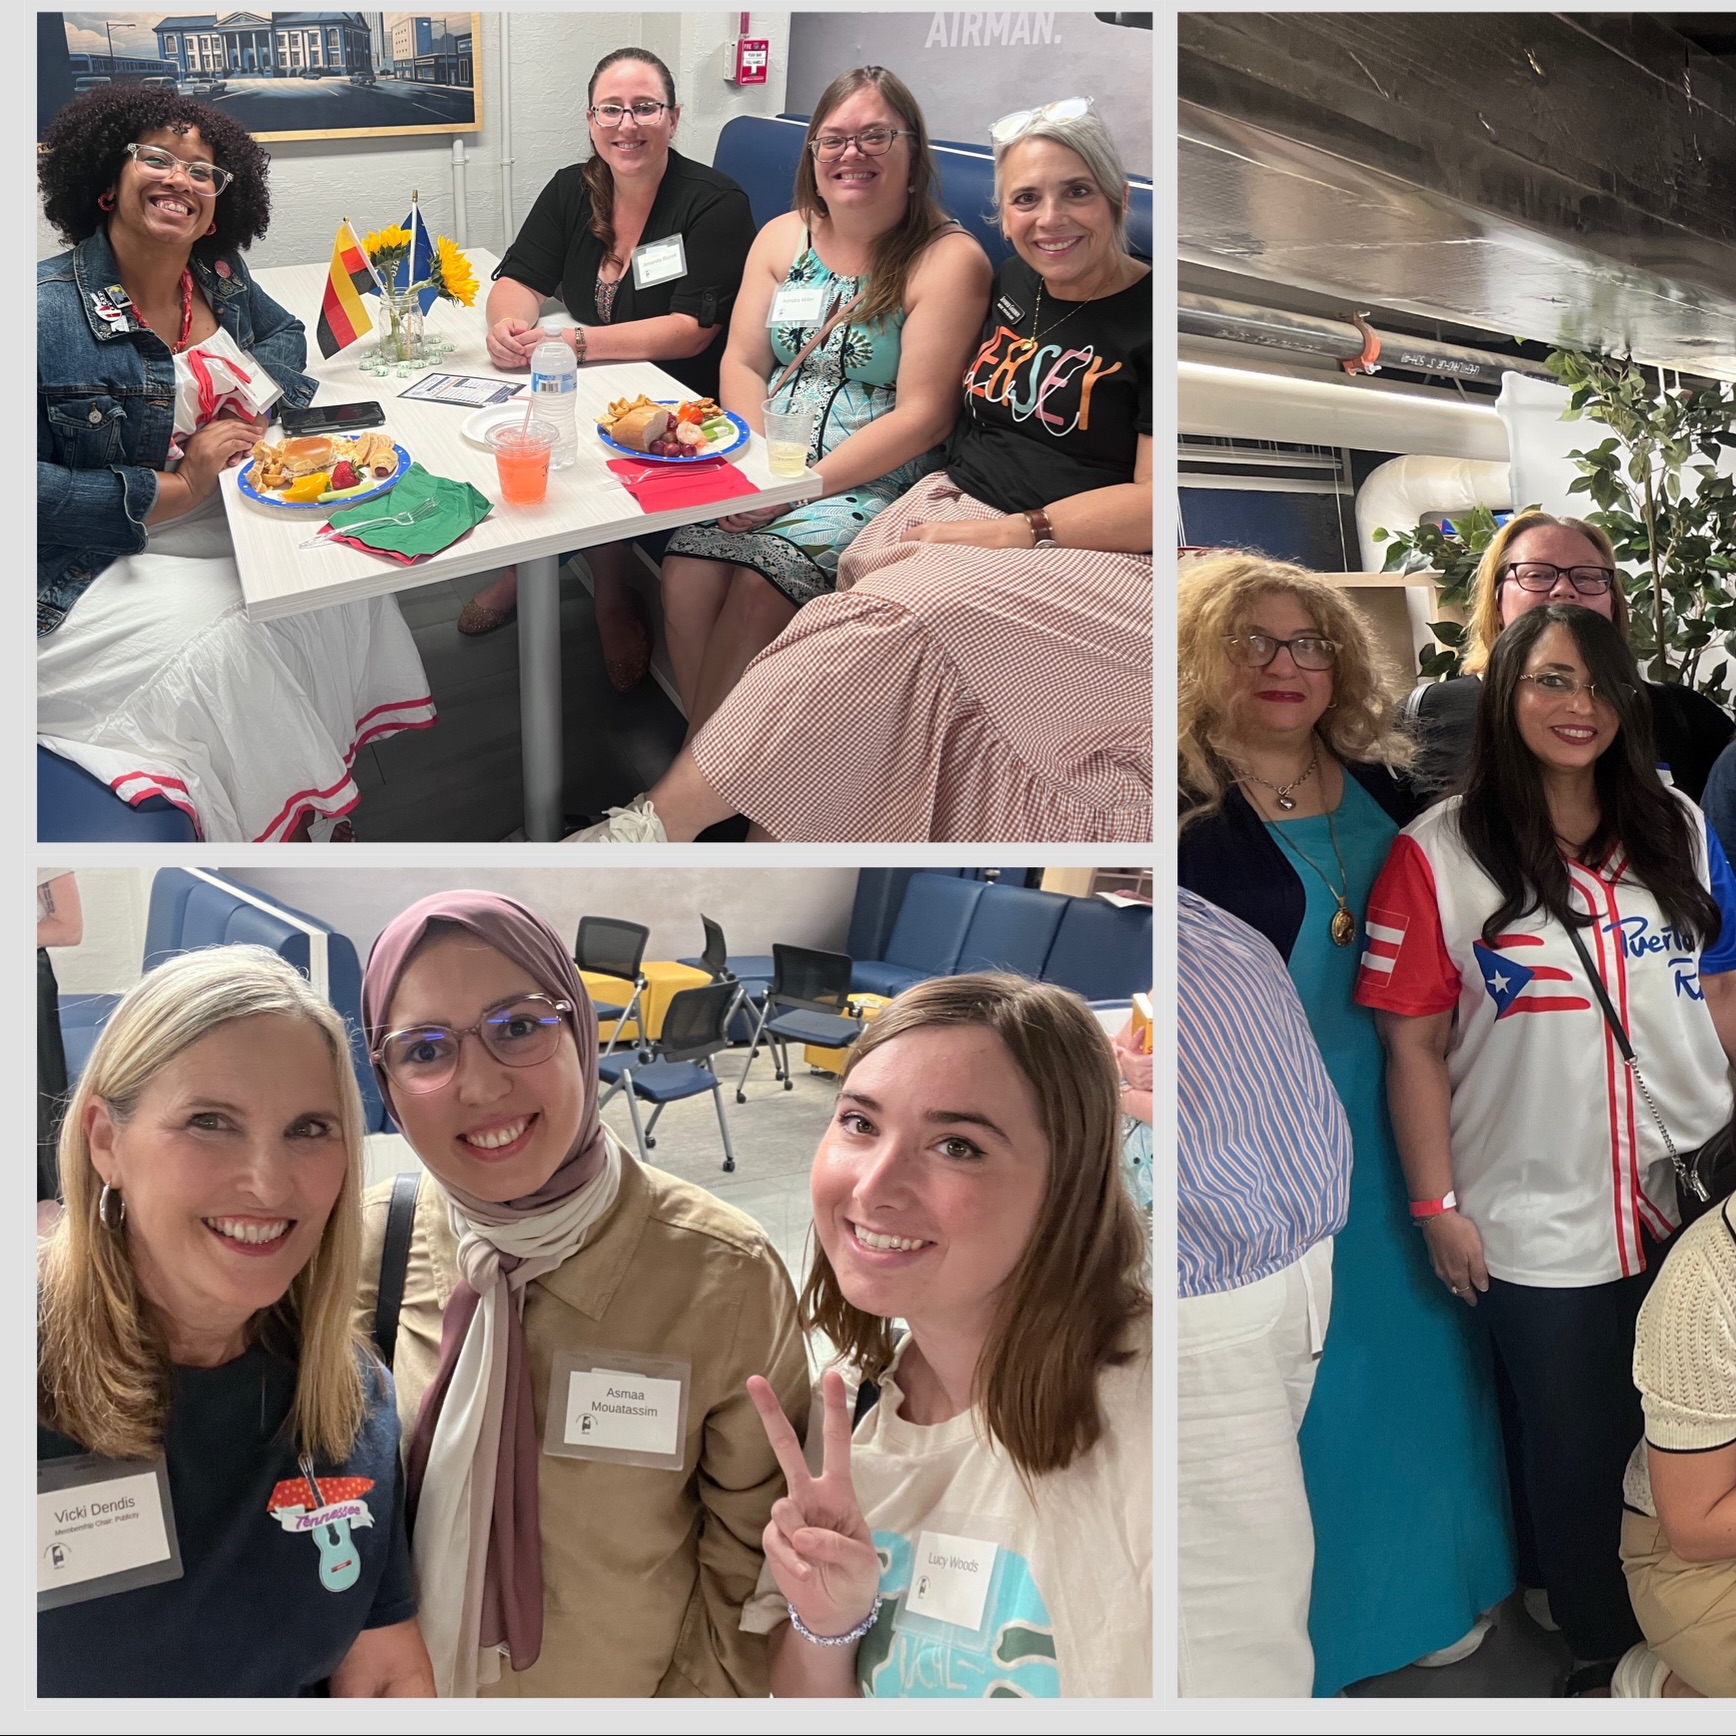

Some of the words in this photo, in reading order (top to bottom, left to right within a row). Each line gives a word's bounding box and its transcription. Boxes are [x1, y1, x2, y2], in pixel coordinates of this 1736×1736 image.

[606, 1387, 645, 1401] Asmaa
[591, 1401, 658, 1417] Mouatassim
[54, 1505, 87, 1524] Vicki
[91, 1496, 136, 1516] Dendis
[294, 1504, 362, 1530] Tennessee
[54, 1522, 94, 1537] Membership
[114, 1512, 140, 1523] Publicity
[928, 1551, 948, 1570] Lucy
[949, 1555, 979, 1574] Woods
